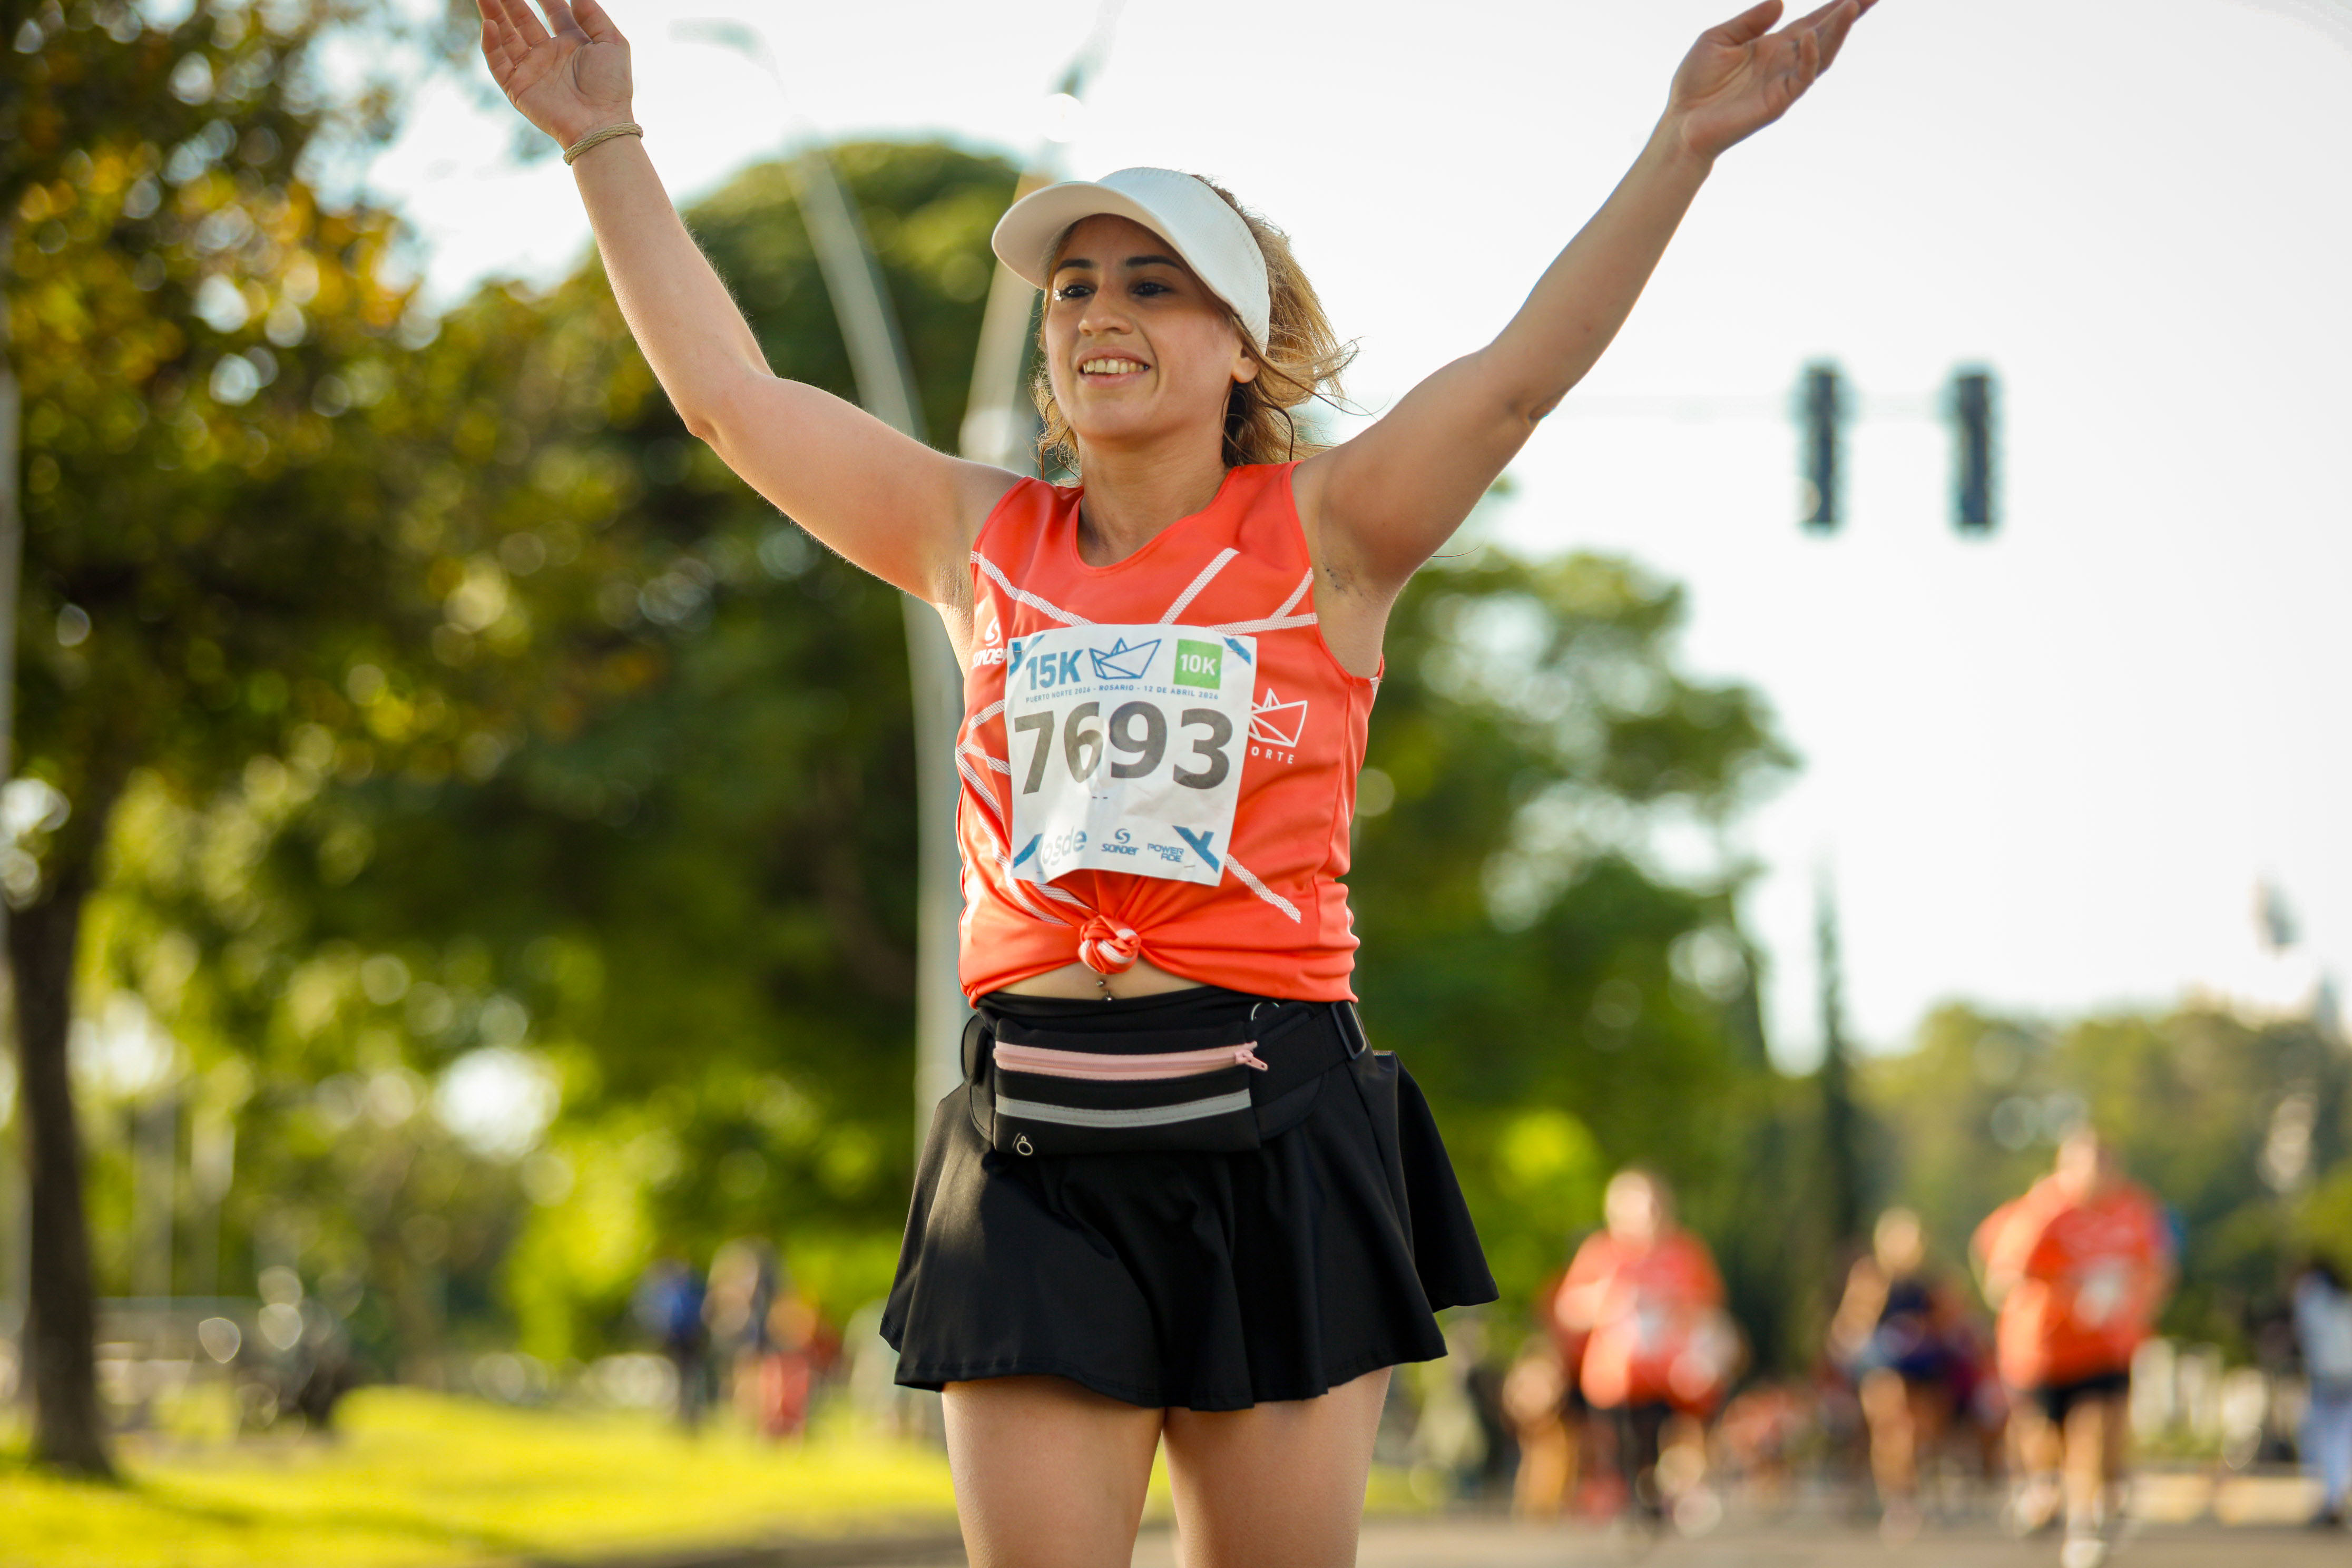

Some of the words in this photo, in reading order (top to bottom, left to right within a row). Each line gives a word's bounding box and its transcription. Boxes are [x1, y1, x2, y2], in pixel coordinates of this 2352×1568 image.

[1026, 649, 1084, 690] 15K
[1180, 654, 1216, 676] 10K
[1026, 693, 1050, 703] PUERTO
[1052, 689, 1073, 699] NORTE
[1074, 687, 1091, 695] 2026
[1170, 688, 1195, 697] ABRIL
[1198, 691, 1219, 700] 2026
[1014, 700, 1233, 795] 7693
[1251, 746, 1295, 765] ORTE
[1147, 843, 1184, 856] POWER
